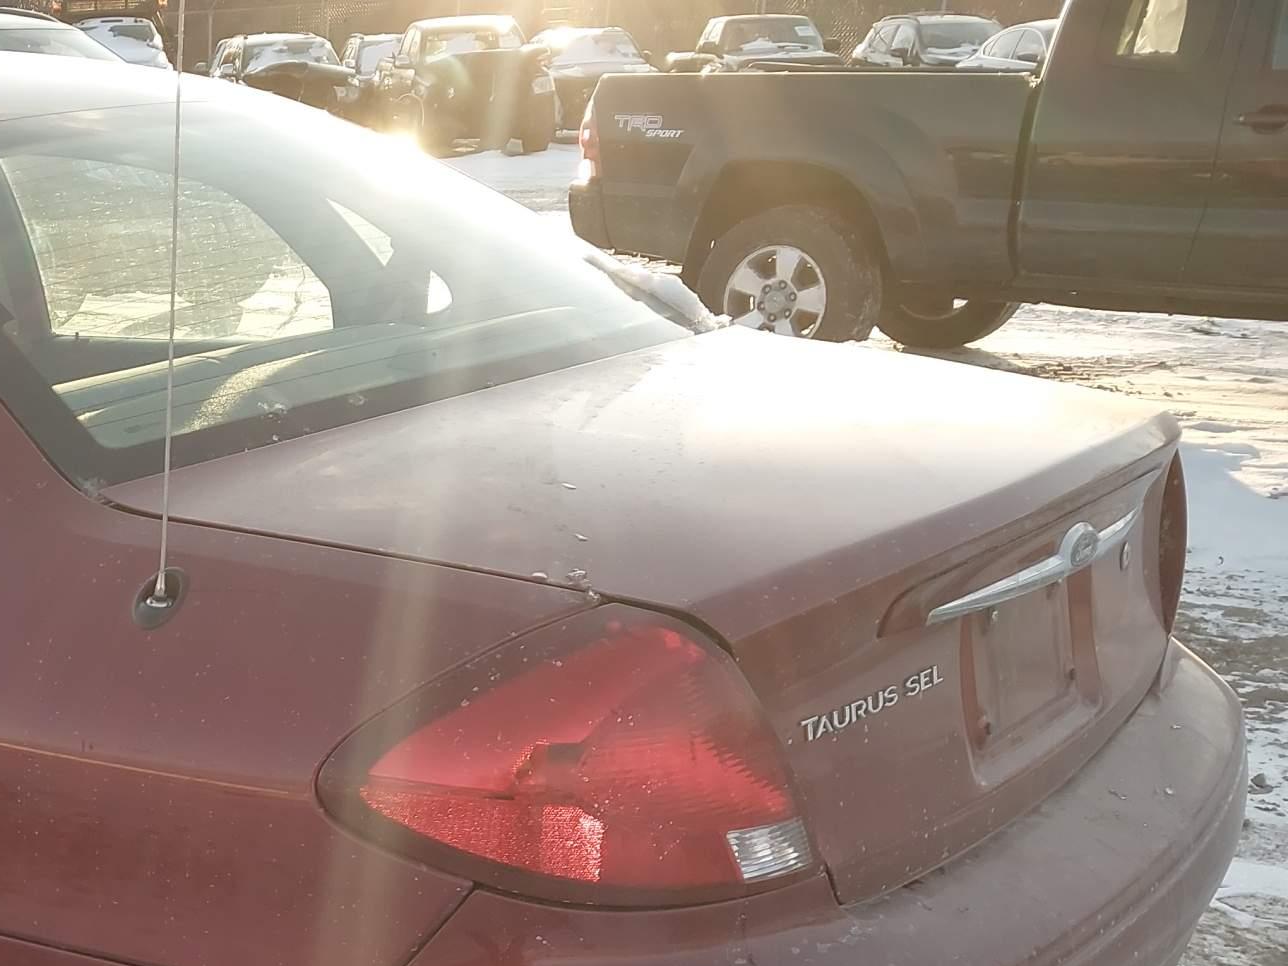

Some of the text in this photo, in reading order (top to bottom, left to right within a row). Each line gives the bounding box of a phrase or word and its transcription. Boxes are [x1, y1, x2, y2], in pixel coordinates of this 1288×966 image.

[614, 113, 663, 132] TRD
[645, 128, 685, 139] SPORT
[800, 664, 944, 742] TAURUS SEL
